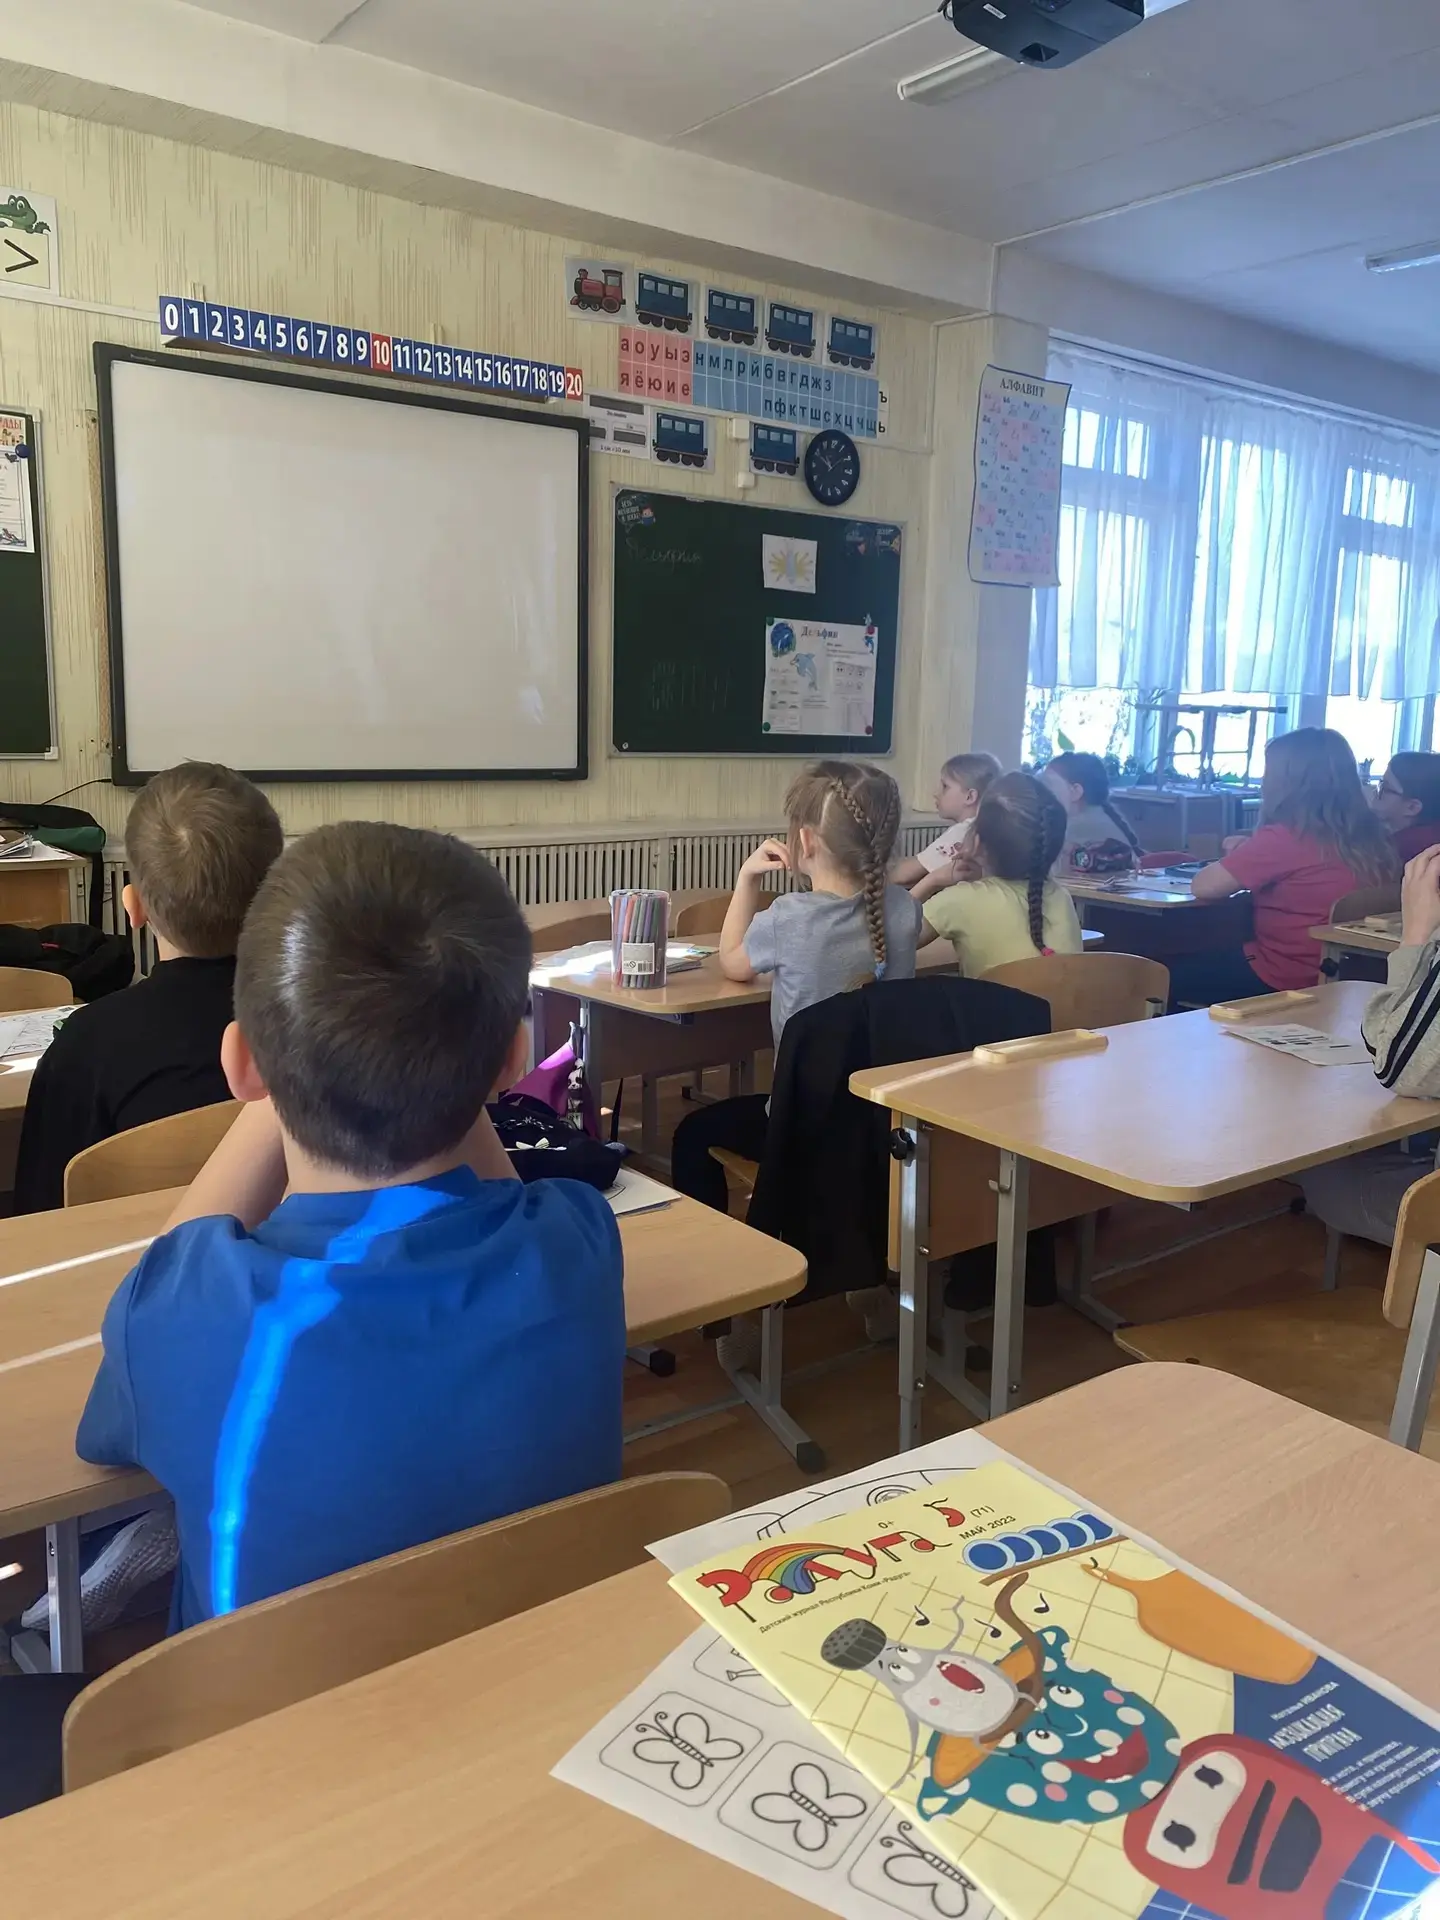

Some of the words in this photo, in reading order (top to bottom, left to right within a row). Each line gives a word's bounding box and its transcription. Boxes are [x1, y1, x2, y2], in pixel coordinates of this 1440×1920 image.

[164, 304, 179, 330] 0
[188, 307, 200, 333] 1
[211, 311, 223, 337] 2
[233, 315, 245, 340] 3
[254, 320, 267, 345] 4
[276, 323, 287, 348] 5
[296, 327, 308, 351] 6
[316, 330, 328, 354] 7
[337, 333, 348, 358] 8
[356, 337, 368, 361] 9
[374, 340, 390, 366] 10
[394, 343, 410, 369] 11
[415, 348, 432, 373] 12
[435, 351, 451, 376] 13
[455, 355, 472, 379] 14
[475, 358, 492, 382] 15
[495, 361, 511, 385] 16
[513, 364, 529, 388] 17
[532, 367, 547, 390] 18
[549, 370, 565, 393] 19
[567, 373, 582, 396] 20
[621, 338, 629, 352] а
[635, 341, 644, 354] о
[651, 343, 660, 361] у
[665, 347, 677, 360] ы
[682, 350, 690, 362] э
[695, 352, 704, 365] н
[709, 355, 719, 368] м
[724, 358, 732, 371] л
[737, 361, 745, 376] р
[751, 361, 759, 377] й
[764, 363, 773, 379] б
[778, 370, 786, 382] в
[789, 372, 797, 384] г
[800, 375, 809, 389] д
[811, 377, 821, 390] ж
[824, 380, 832, 391] з
[621, 373, 629, 386] я
[635, 371, 643, 388] ё
[648, 378, 662, 391] ю
[667, 380, 675, 394] и
[682, 383, 690, 396] е
[764, 399, 772, 411] п
[775, 398, 786, 418] ф
[789, 404, 796, 416] к
[800, 406, 807, 417] т
[811, 409, 820, 420] ш
[824, 411, 830, 423] с
[835, 413, 841, 425] х
[845, 415, 852, 430] ц
[857, 417, 863, 428] ч
[867, 420, 877, 434] щ
[879, 421, 885, 433] ь
[1000, 378, 1045, 398] АЛФАВИТ
[878, 1520, 895, 1530] 0+
[959, 1524, 987, 1540] МАЙ
[987, 1515, 1016, 1530] 2023
[970, 1505, 995, 1519] (71)
[759, 1614, 793, 1634] Детский
[792, 1602, 820, 1619] журнал
[819, 1587, 862, 1606] Республики
[861, 1580, 882, 1592] Коми
